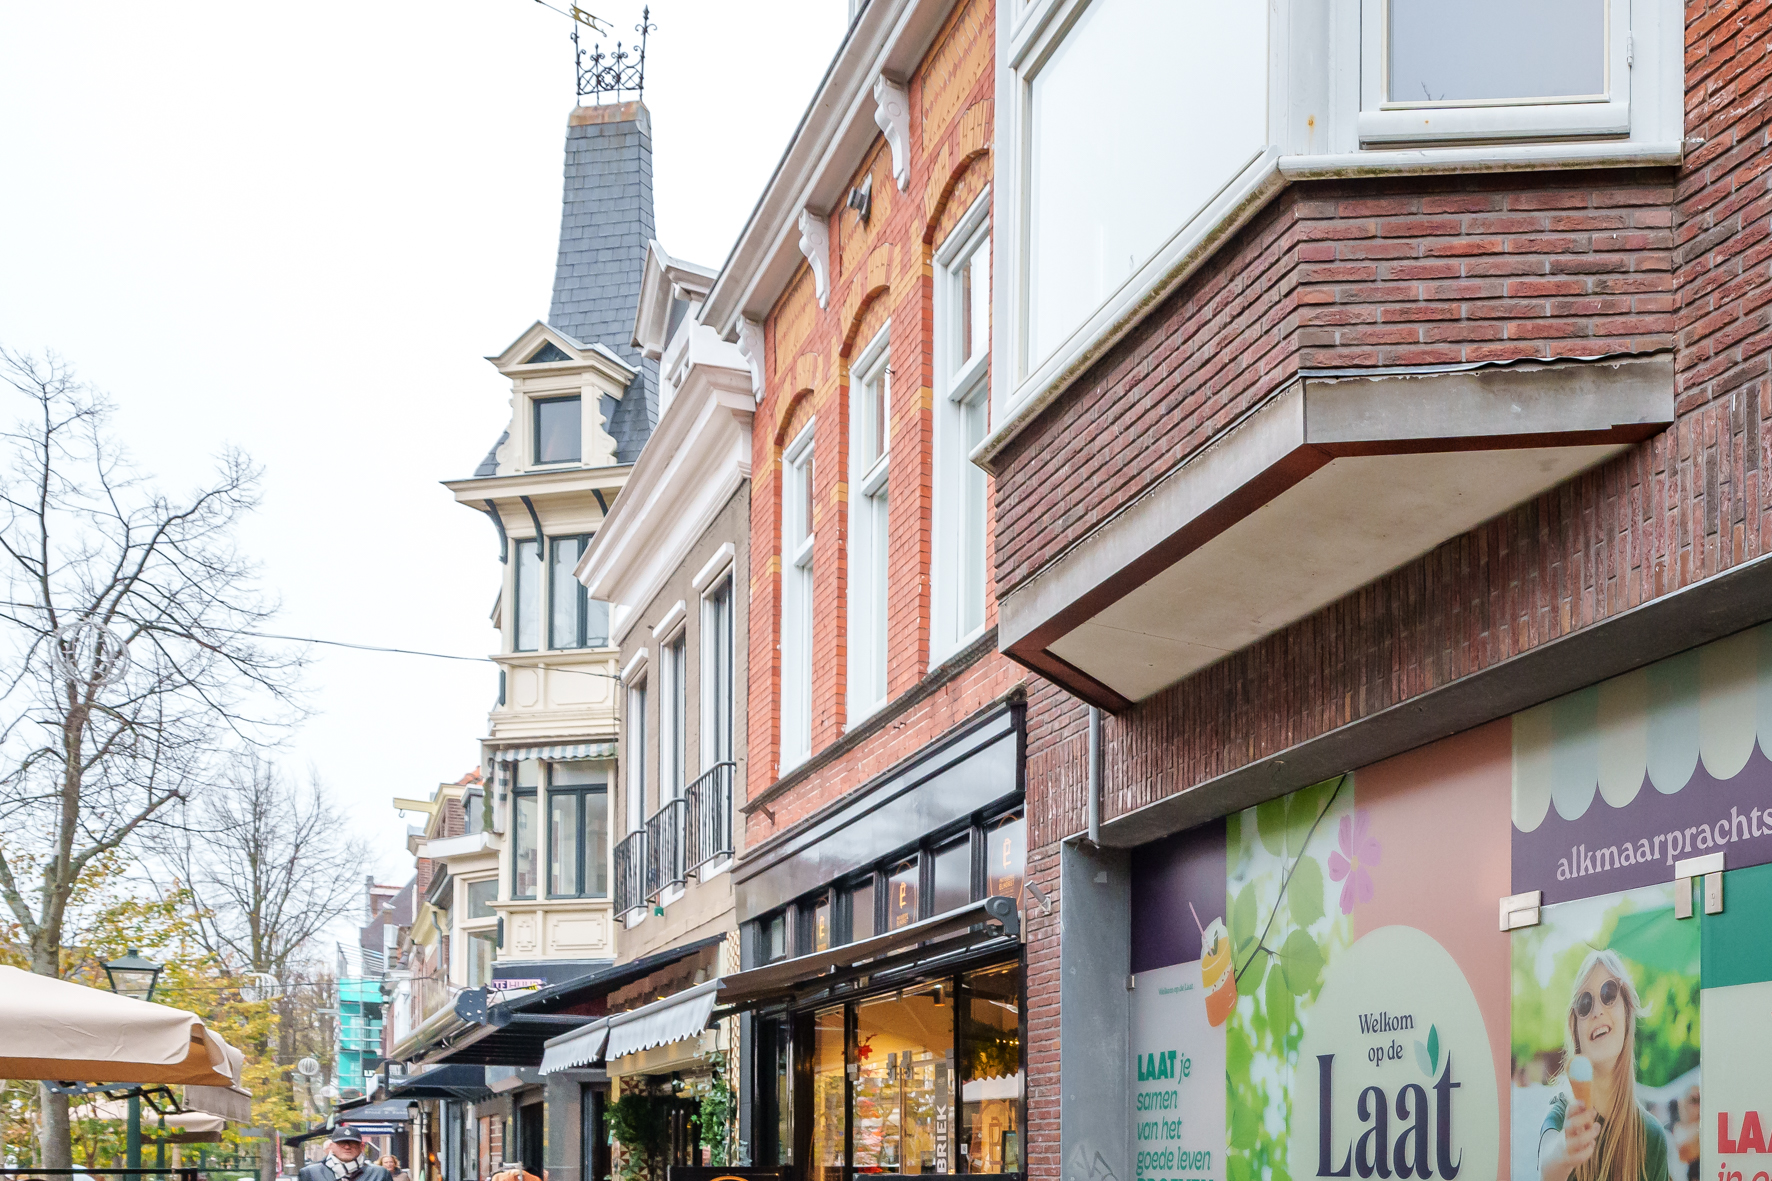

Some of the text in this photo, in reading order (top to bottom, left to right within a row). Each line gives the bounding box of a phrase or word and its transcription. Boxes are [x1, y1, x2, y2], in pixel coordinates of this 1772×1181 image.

[1358, 1011, 1414, 1034] Welkom
[1137, 1050, 1191, 1084] LAAT je
[1368, 1040, 1403, 1067] op de
[1136, 1089, 1178, 1111] samen
[1137, 1116, 1182, 1140] van het
[1316, 1048, 1462, 1181] Laat
[1136, 1146, 1210, 1176] goede leven
